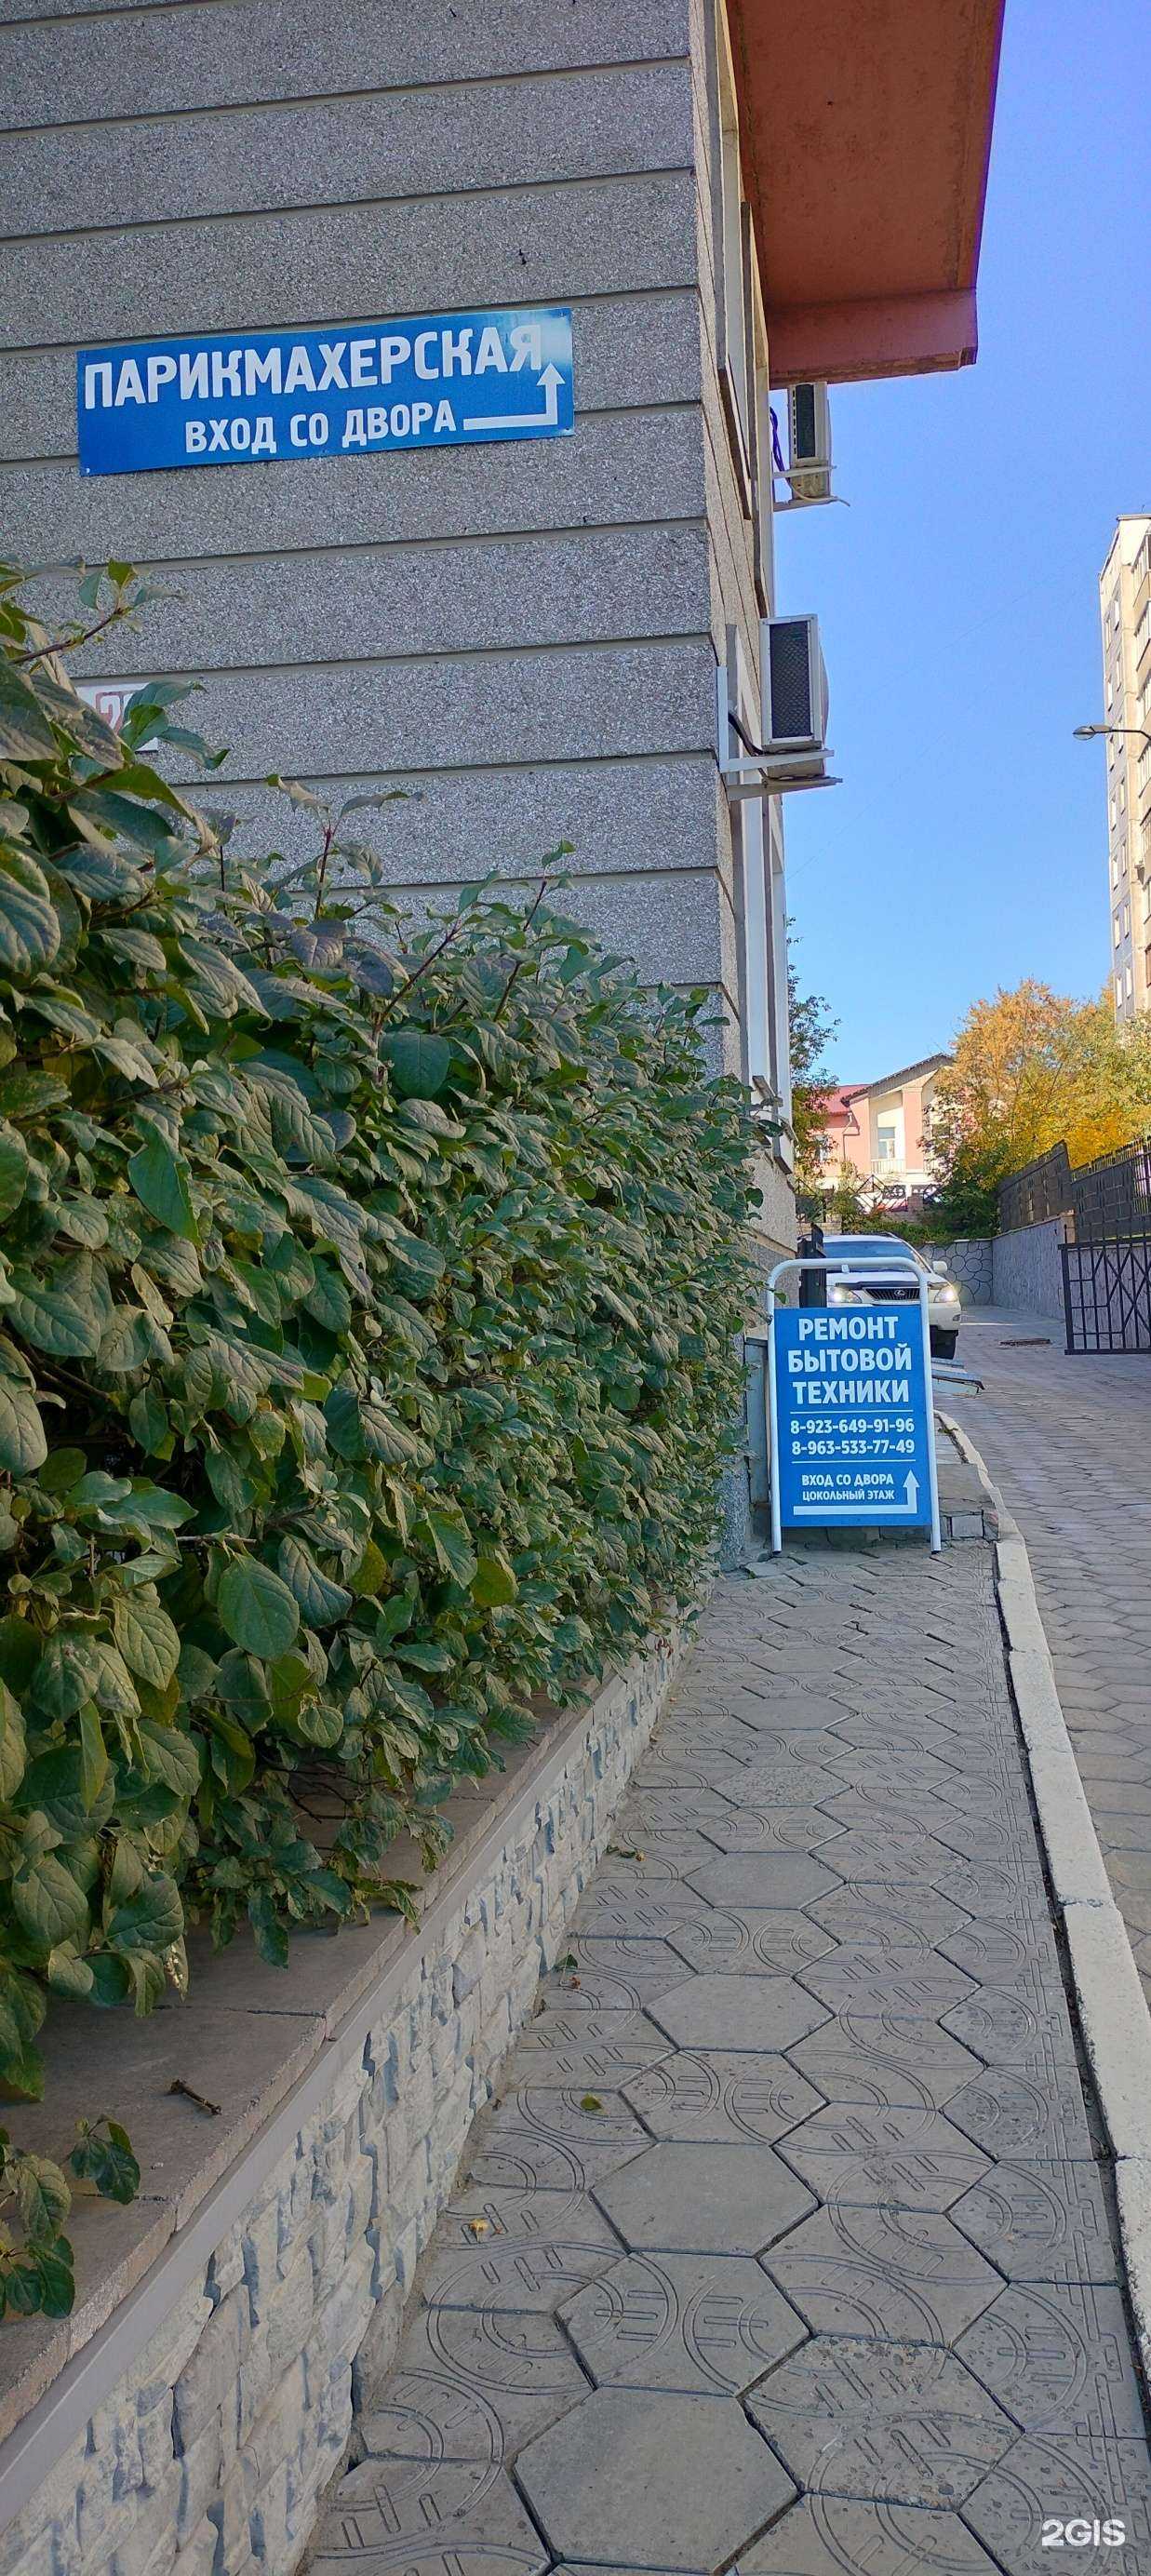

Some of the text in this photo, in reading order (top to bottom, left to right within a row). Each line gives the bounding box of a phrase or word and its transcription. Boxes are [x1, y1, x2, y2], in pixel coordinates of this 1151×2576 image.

[84, 324, 542, 409] ПАРИКМАХЕРСКАЯ
[185, 400, 457, 454] ВХОД СО ДВОРА
[798, 1316, 899, 1341] РЕМОНТ
[788, 1343, 912, 1373] БЫТОВОЙ
[793, 1379, 909, 1404] ТЕХНИКИ
[790, 1417, 915, 1434] 8-923-649-91-96
[792, 1440, 915, 1455] 8-963-533-77-49
[801, 1473, 894, 1487] ВХОД СО ДВОРА
[802, 1488, 895, 1502] ЦОКОЛЬНЫЙ ЭТАЖ
